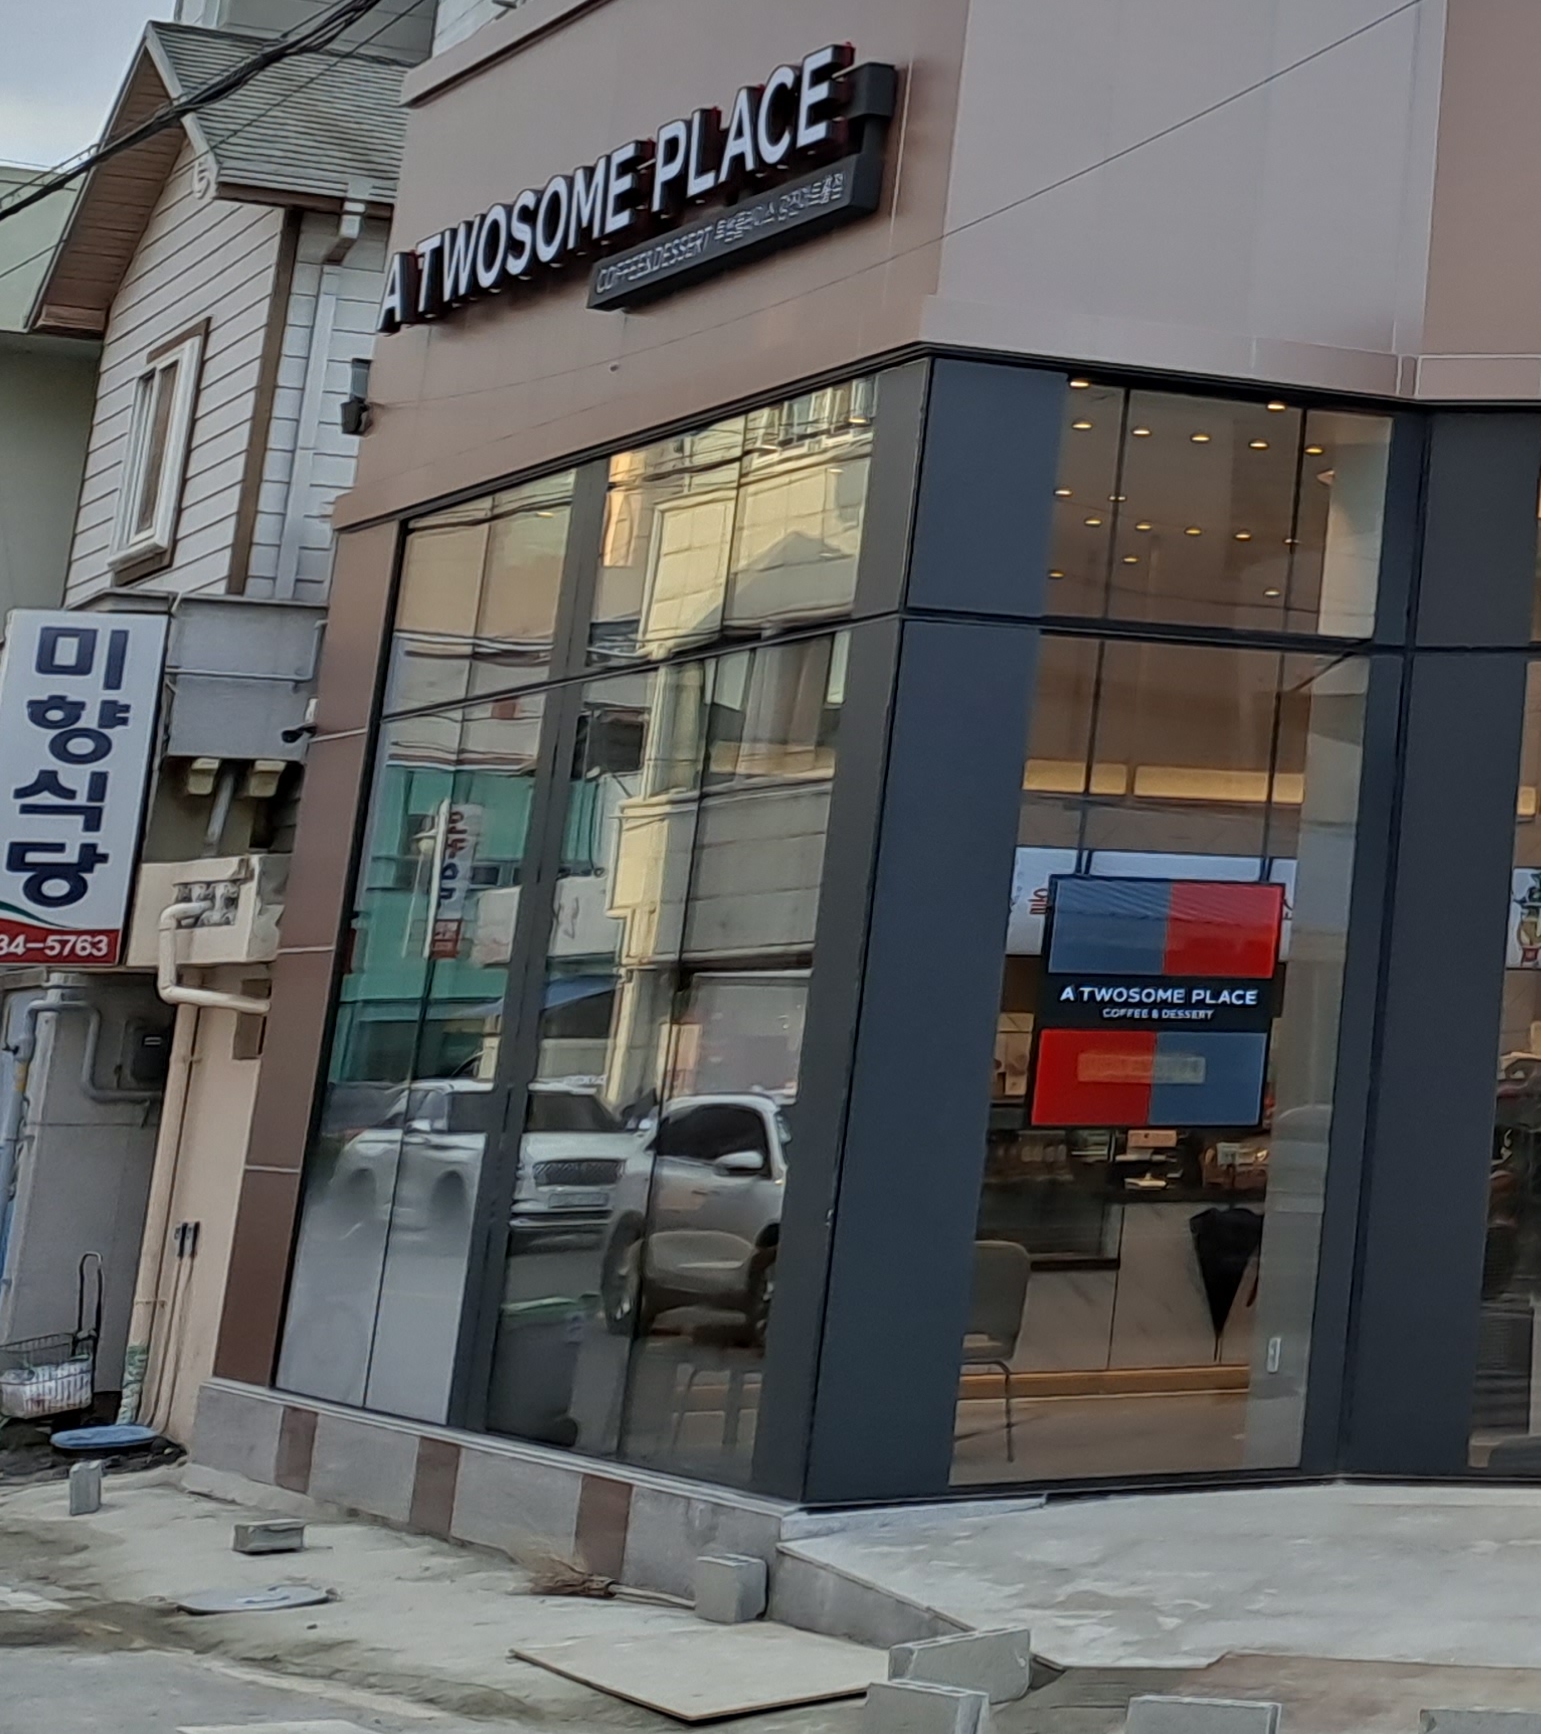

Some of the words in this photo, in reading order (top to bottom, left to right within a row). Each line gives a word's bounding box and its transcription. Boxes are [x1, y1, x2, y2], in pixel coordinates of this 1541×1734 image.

[379, 252, 404, 330] A
[417, 141, 641, 313] TWOSOME
[651, 44, 838, 212] PLACE
[6, 625, 131, 908] 미향식당
[1060, 985, 1075, 1002] A
[1078, 986, 1186, 1004] TWOSOME
[1191, 988, 1259, 1005] PLACE
[1102, 1008, 1149, 1019] COFFEE
[1162, 1008, 1214, 1019] DESSERT
